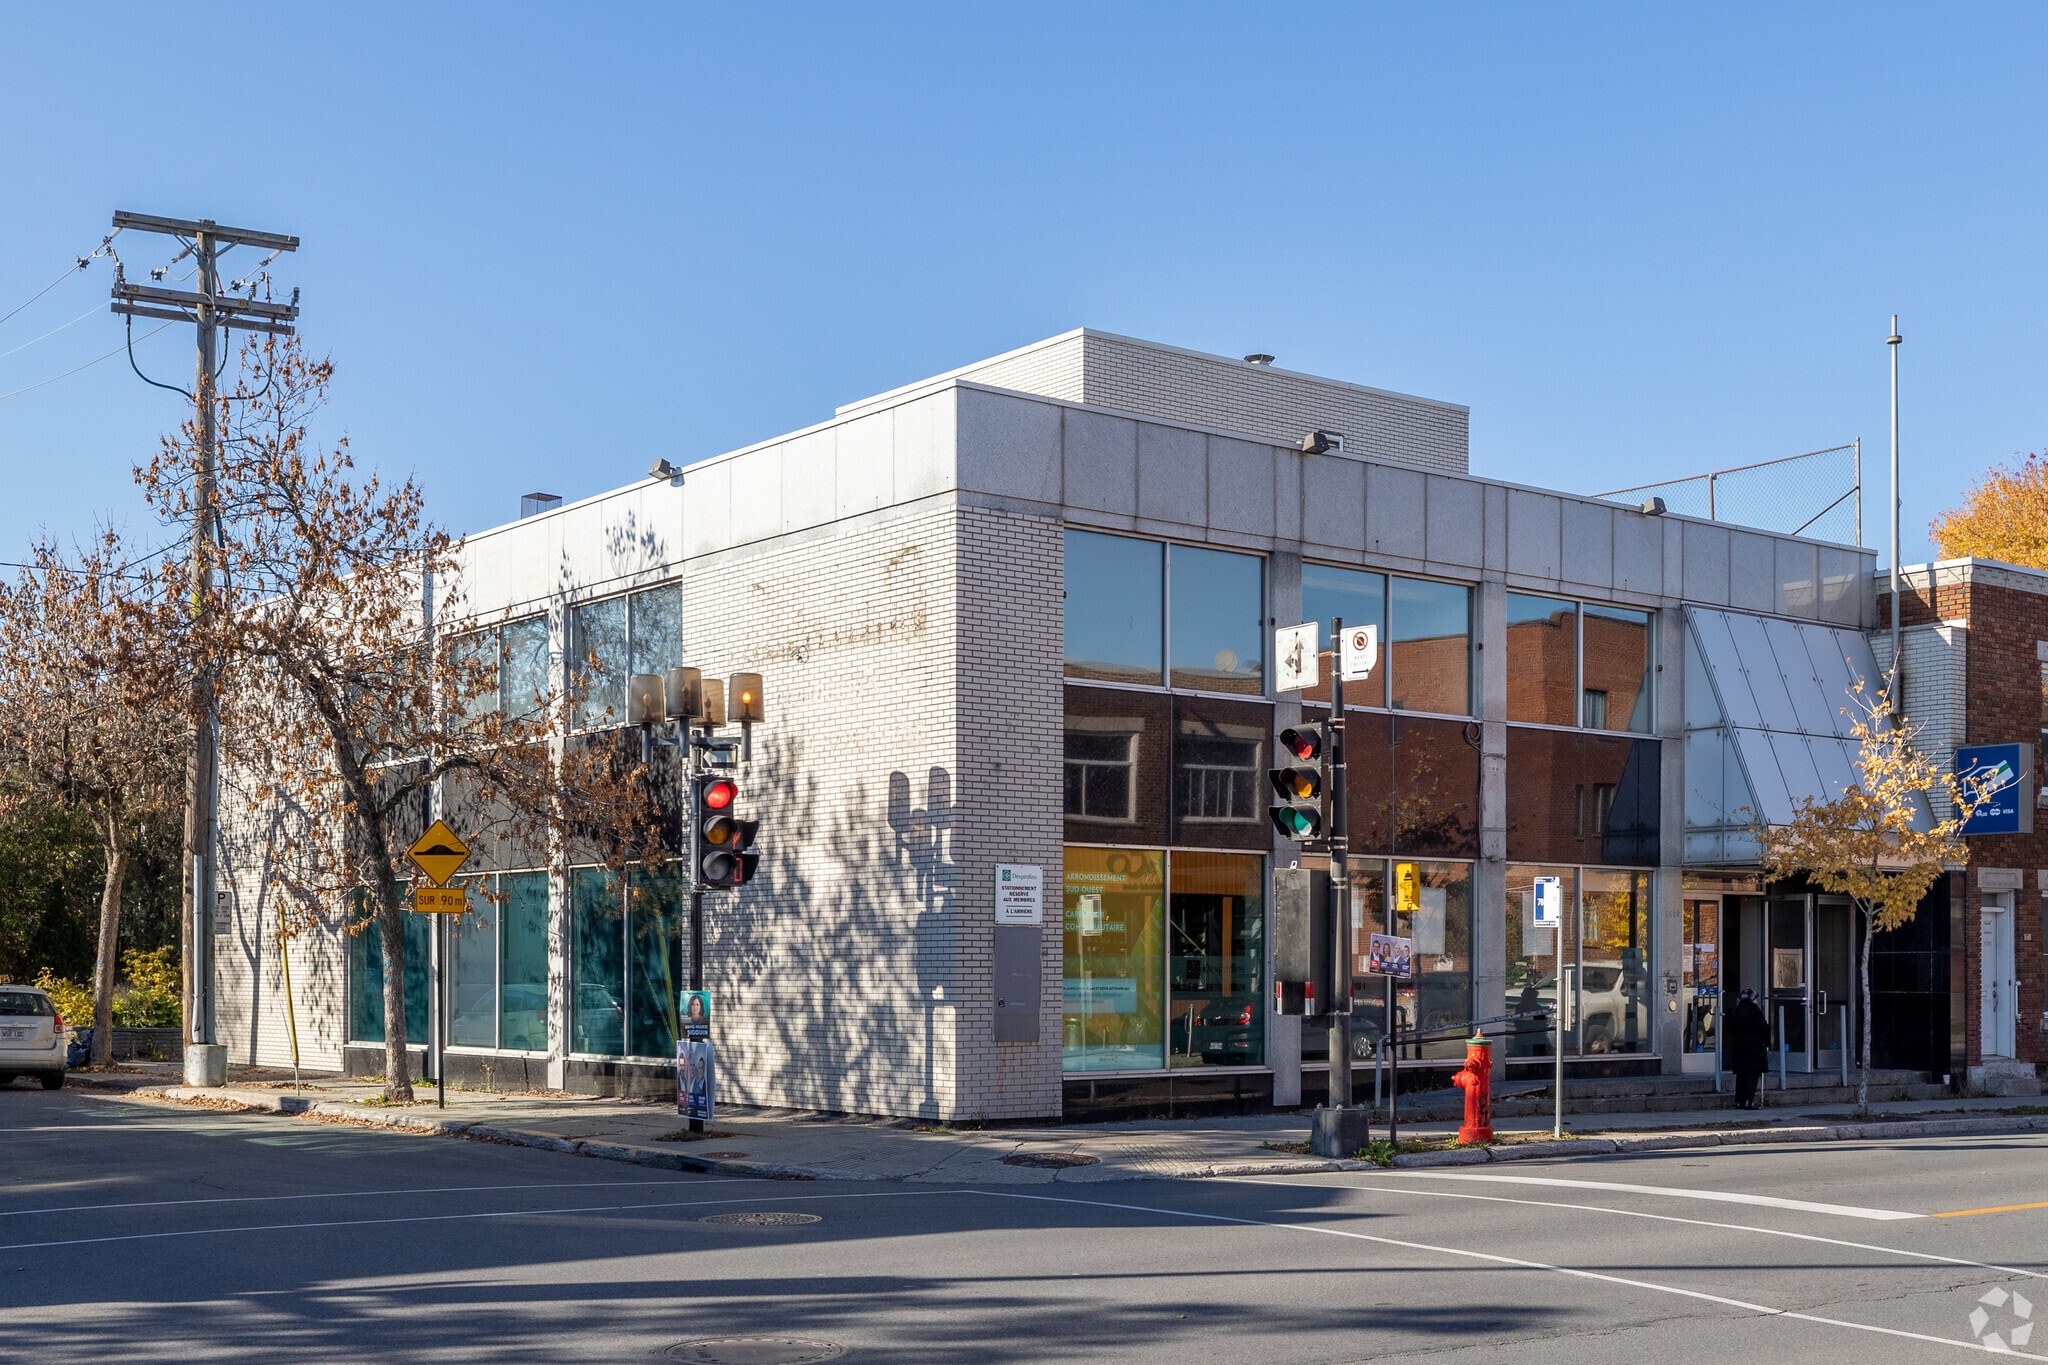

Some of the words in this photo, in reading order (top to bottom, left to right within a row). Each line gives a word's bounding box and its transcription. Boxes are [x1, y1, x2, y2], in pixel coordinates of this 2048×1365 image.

[1066, 873, 1127, 882] ARRONDISSEMENT
[218, 893, 225, 904] P
[418, 895, 435, 905] SUR
